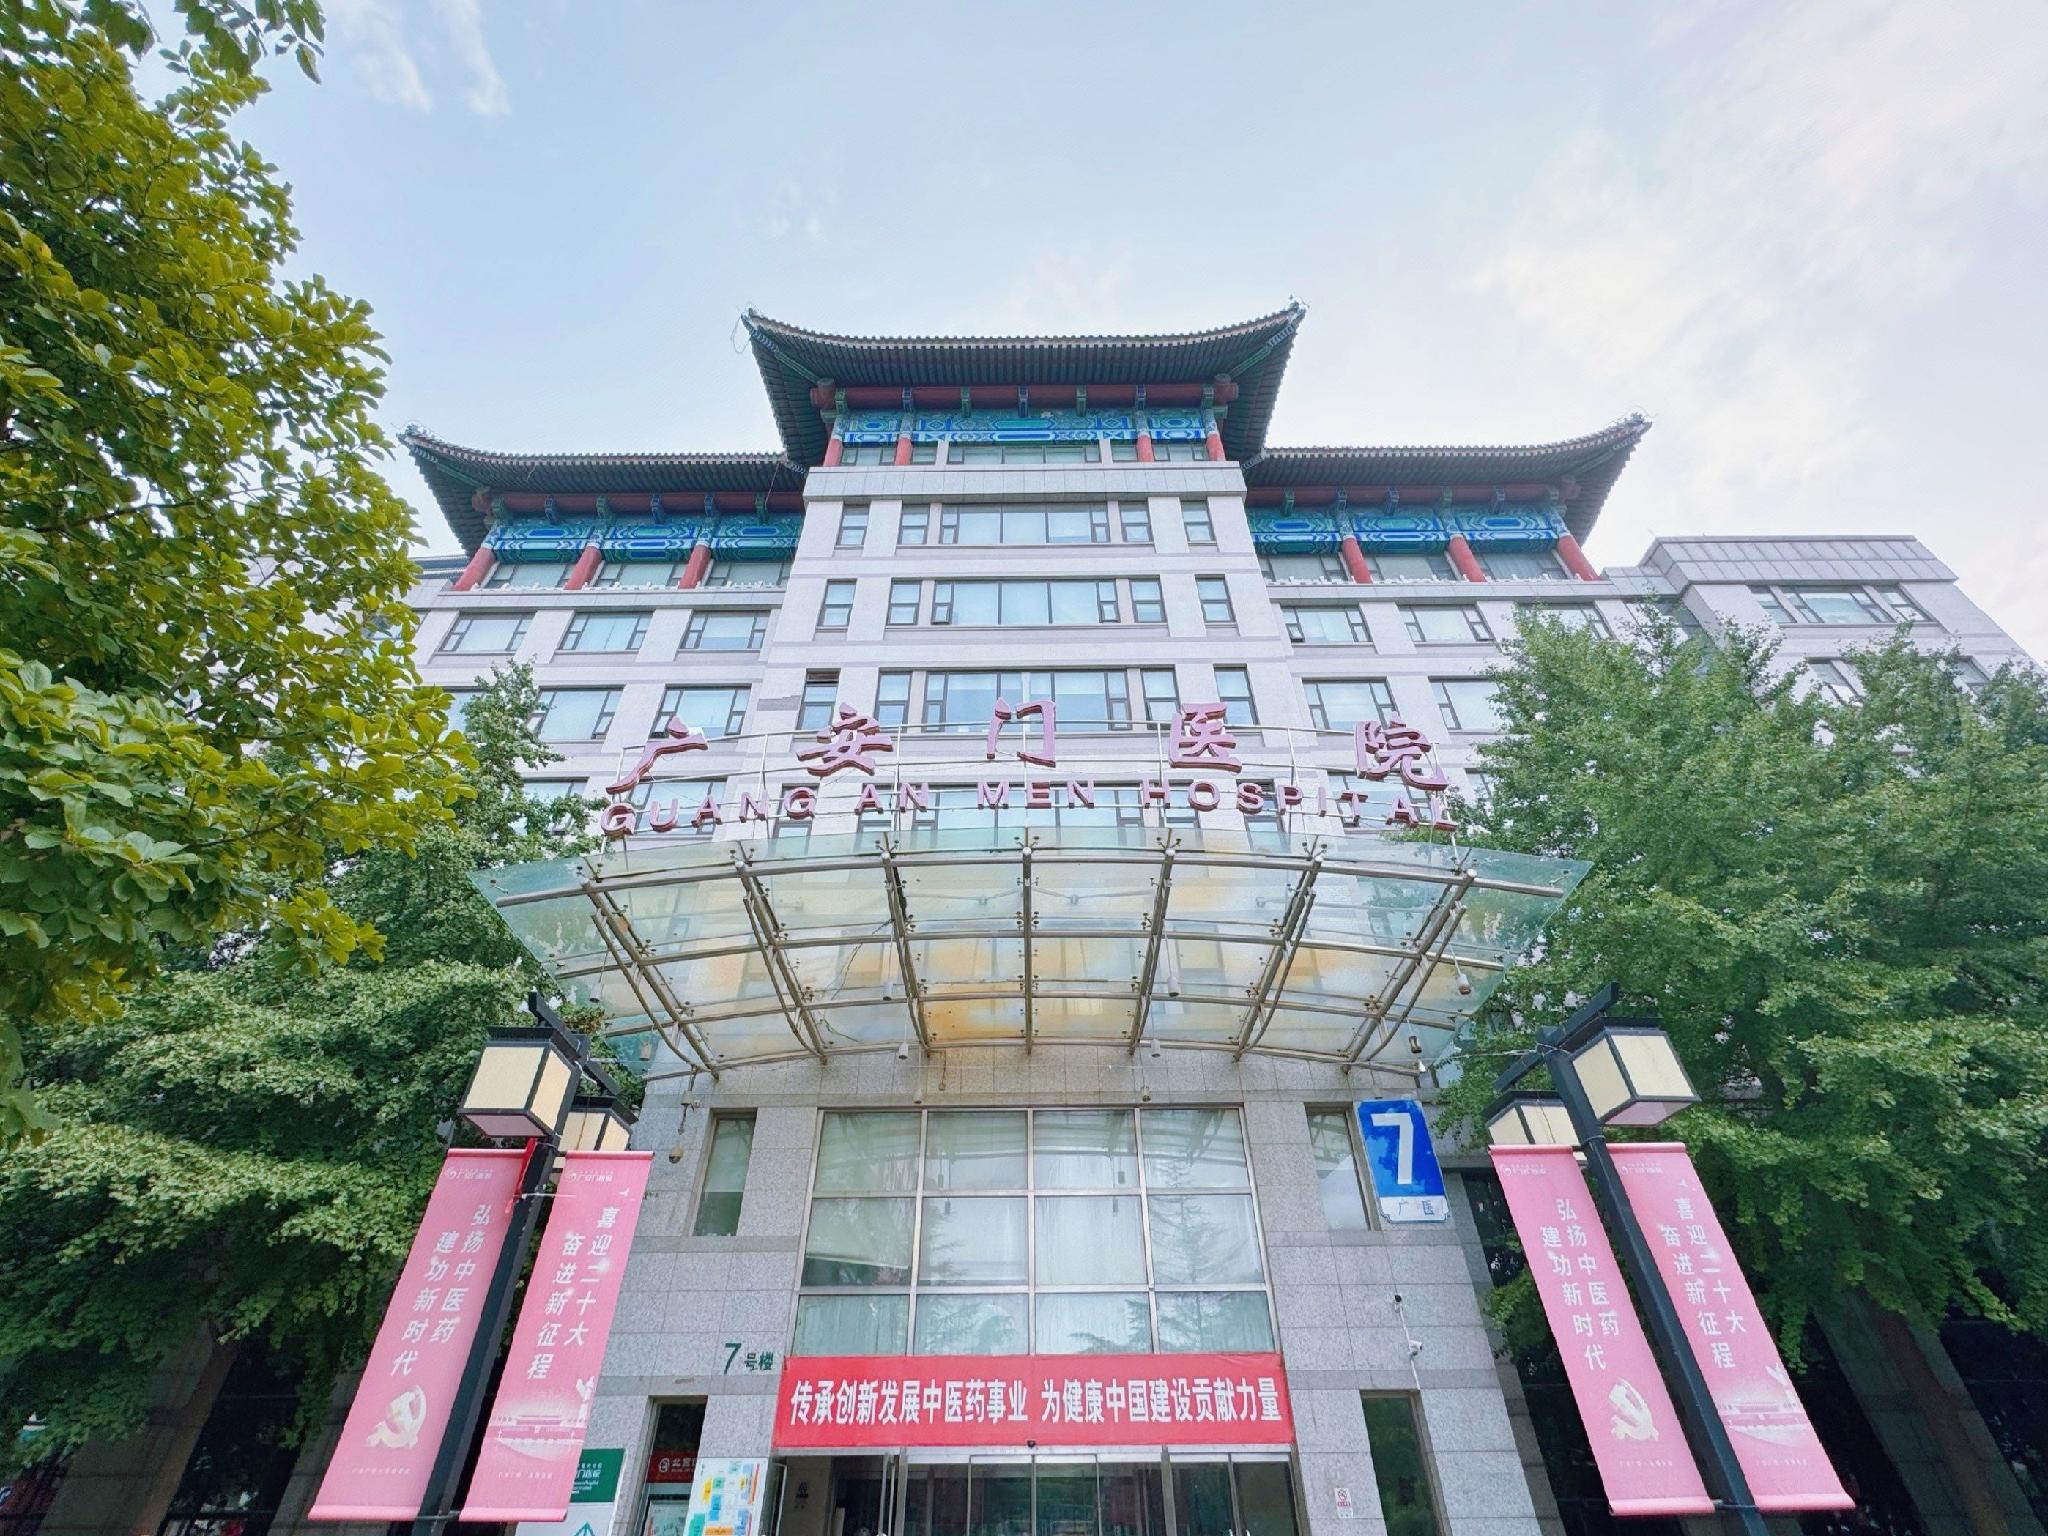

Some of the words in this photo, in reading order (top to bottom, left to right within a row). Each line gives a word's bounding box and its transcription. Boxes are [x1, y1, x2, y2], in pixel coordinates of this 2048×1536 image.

[600, 786, 816, 837] GUANG
[855, 783, 929, 815] AN
[977, 780, 1095, 810] MEN
[1140, 779, 1457, 832] HOSPITAL
[606, 697, 1448, 791] 广安门医院
[1370, 1112, 1414, 1185] 7
[390, 1230, 459, 1376] 建功新时代
[429, 1204, 491, 1343] 弘扬中医药
[527, 1232, 585, 1379] 奋进新征程
[564, 1206, 620, 1346] 喜迎二十大
[1540, 1226, 1607, 1370] 建功新时代
[1556, 1199, 1619, 1336] 弘扬中医药
[1658, 1224, 1736, 1369] 奋进新征程
[1674, 1198, 1746, 1333] 喜迎二十大
[724, 1342, 774, 1374] 7号楼
[790, 1378, 1028, 1426] 传承创新发展中医药事业
[1041, 1377, 1282, 1424] 为健康中国建设贡献力量
